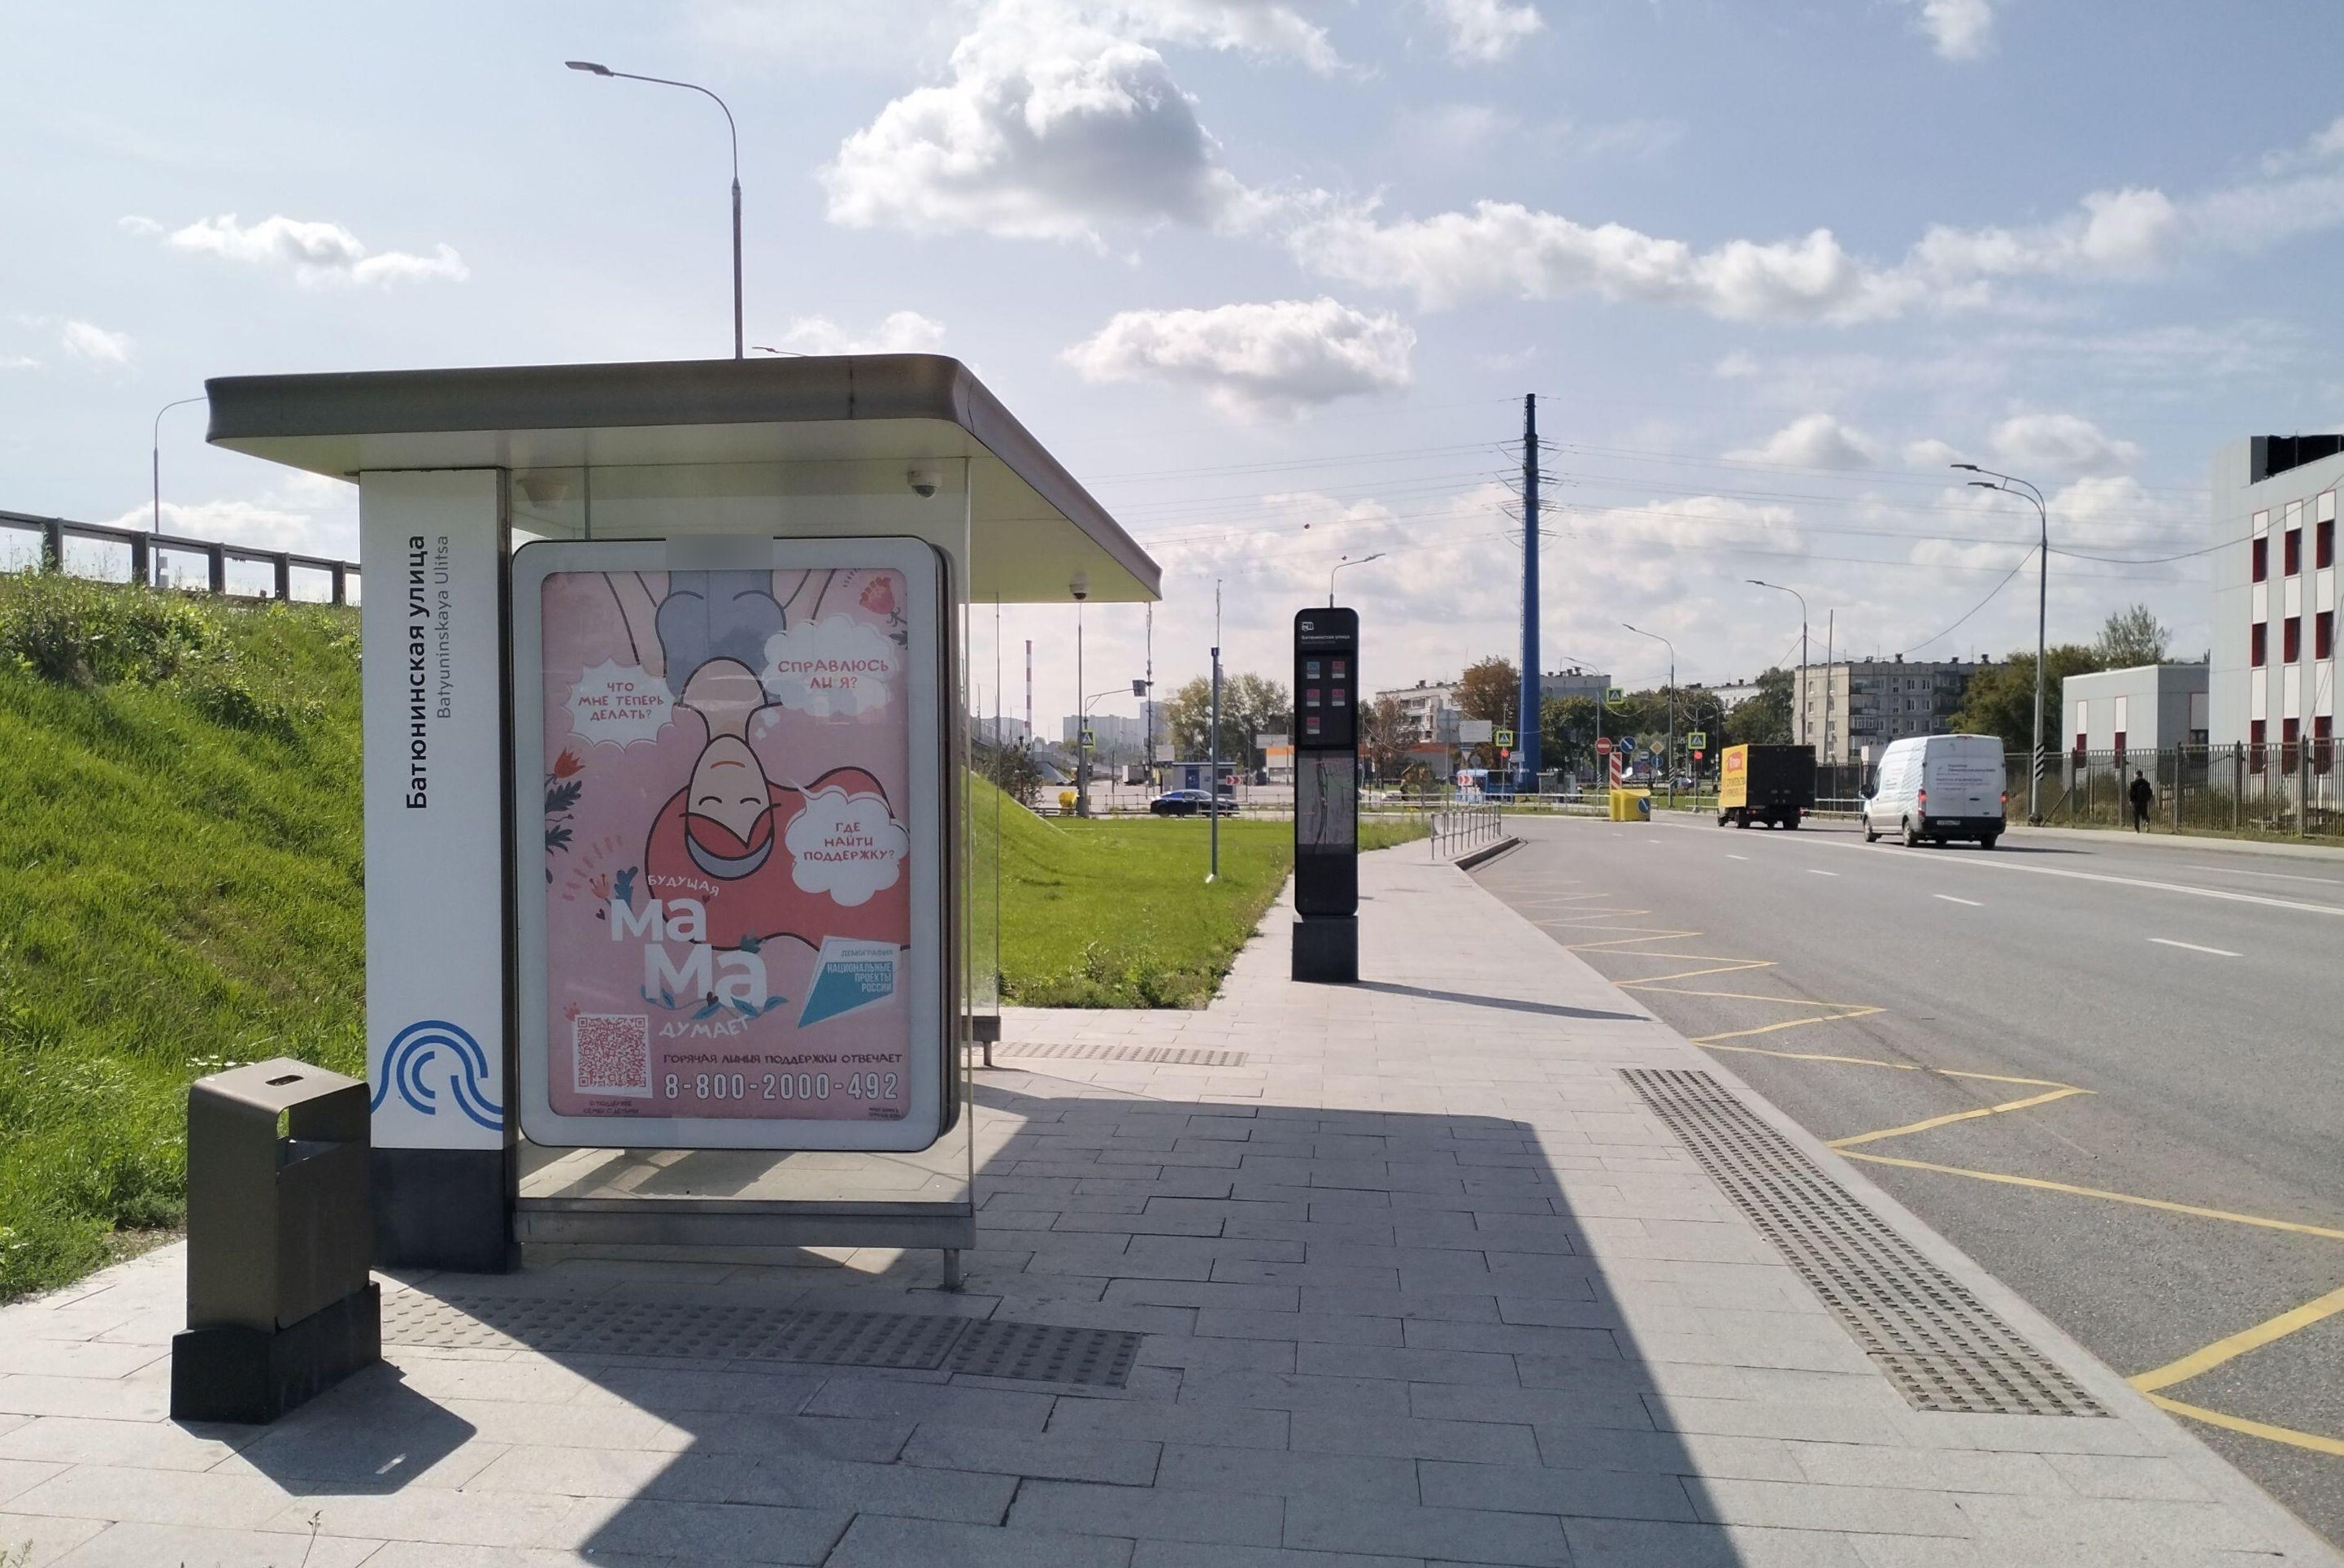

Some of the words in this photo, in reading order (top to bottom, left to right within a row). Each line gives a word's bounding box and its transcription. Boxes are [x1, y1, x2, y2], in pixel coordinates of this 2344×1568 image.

[434, 535, 449, 584] Ulitsa
[408, 535, 430, 619] улица
[434, 590, 454, 719] Batyuninskaya
[777, 659, 889, 673] СПРАВЛЮСЬ
[607, 681, 635, 692] ЧТО
[809, 676, 834, 689] ЛИ
[841, 675, 858, 689] Я?
[578, 696, 610, 706] МНЕ
[615, 695, 664, 706] ТЕПЕРЬ
[407, 624, 429, 809] Батюнинская
[589, 709, 652, 722] ДЕЛАТЬ?
[835, 823, 860, 834] ГДЕ
[824, 835, 873, 847] НАЙТИ
[803, 849, 895, 863] ПОДДЕРЖКУ?
[647, 875, 720, 897] БУДУЩАЯ
[841, 949, 894, 958] ДЕМОГРАФИЯ
[827, 962, 892, 974] НАЦИОНАЛЬНЫЕ
[855, 973, 892, 983] ПРОЕКТЫ
[861, 984, 892, 992] РОССИИ
[659, 1015, 749, 1039] ДУМАЕТ
[663, 1053, 717, 1065] ГОРЯЧАЯ
[721, 1053, 761, 1065] ЛИНИЯ
[764, 1054, 837, 1066] ПОДДЕРЖКИ
[841, 1054, 903, 1065] ОТВЕЧАЕТ
[664, 1071, 899, 1101] 8-800-2000-492
